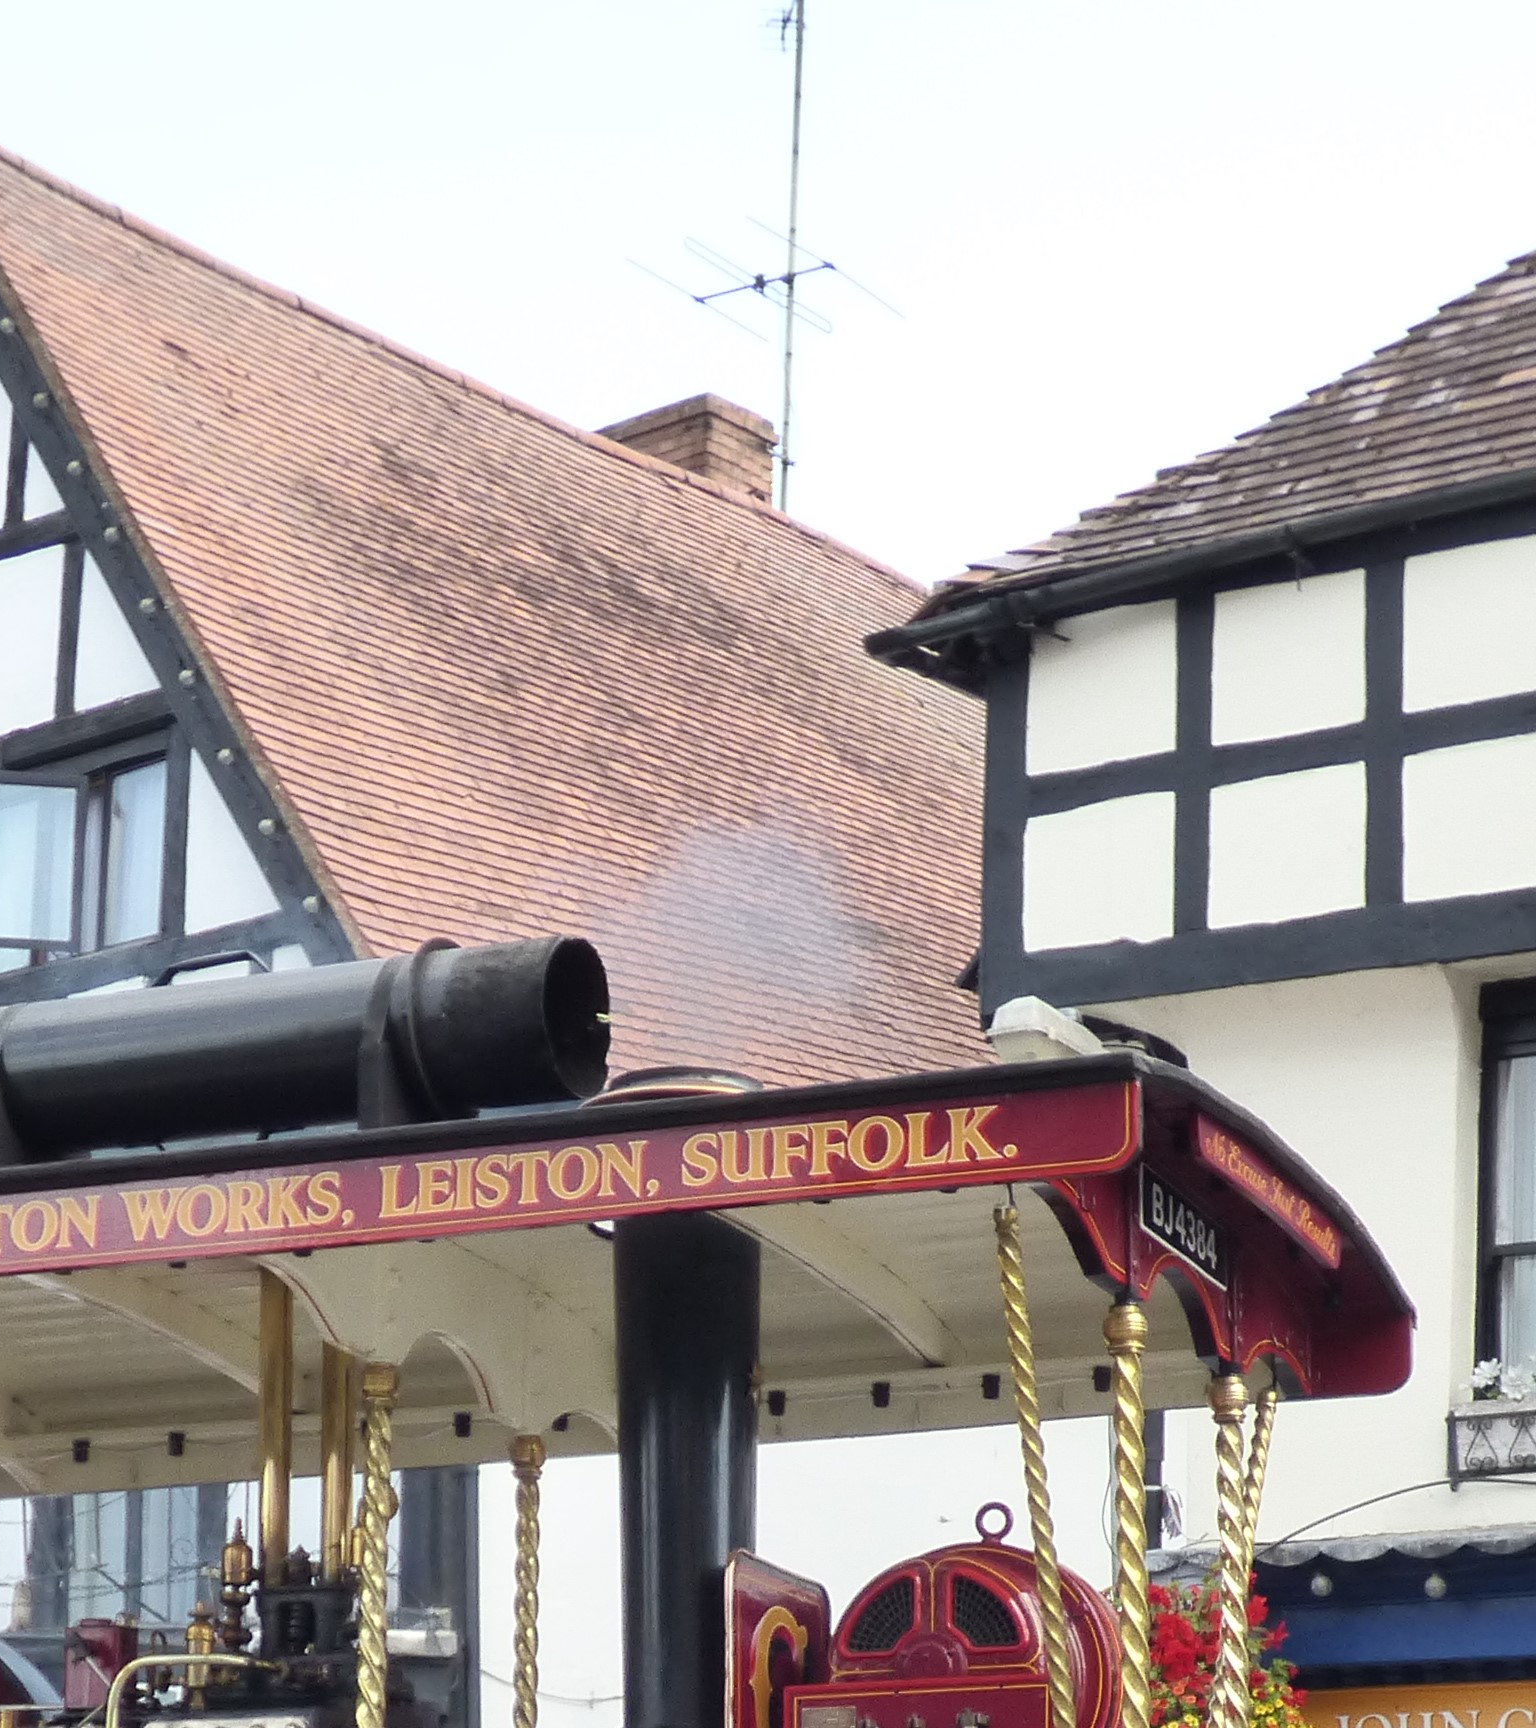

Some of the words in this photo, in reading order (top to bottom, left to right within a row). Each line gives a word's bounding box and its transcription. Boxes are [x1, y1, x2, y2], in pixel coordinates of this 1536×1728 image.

[119, 1171, 354, 1241] WORKS,
[379, 1140, 660, 1218] LEISTON,
[681, 1104, 1018, 1188] SUFFOLK.
[1151, 1181, 1218, 1270] BJ4384
